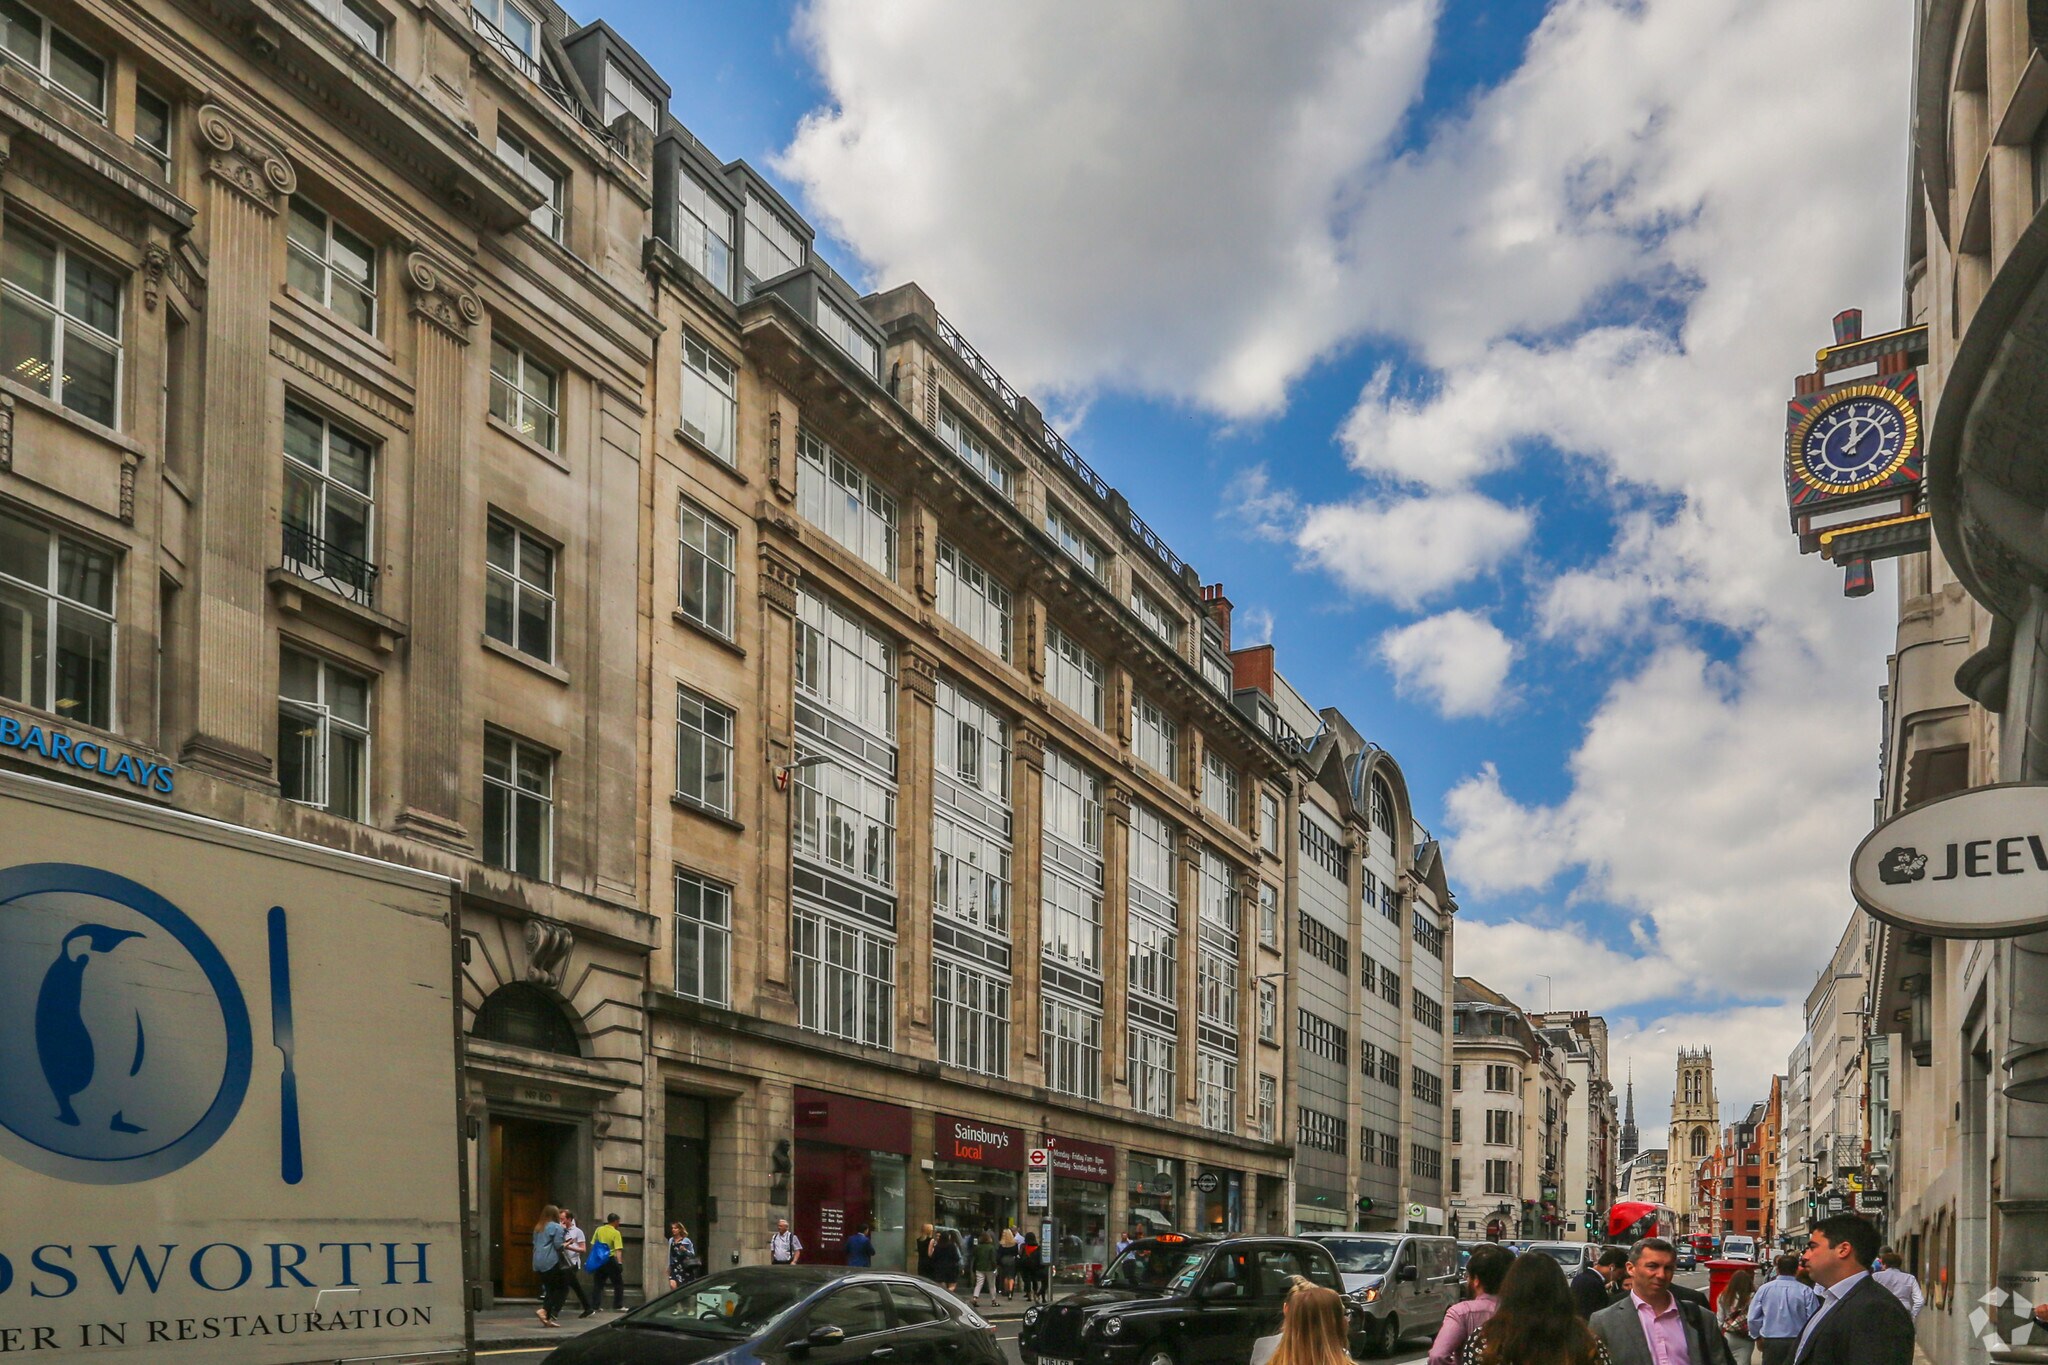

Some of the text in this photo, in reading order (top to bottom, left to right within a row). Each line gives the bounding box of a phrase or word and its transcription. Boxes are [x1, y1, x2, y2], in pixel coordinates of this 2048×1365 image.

[0, 716, 174, 793] BARCLAYS
[954, 1123, 1009, 1149] Sainsbury's
[955, 1140, 983, 1160] Local
[1072, 1152, 1084, 1163] Friday
[1073, 1162, 1087, 1174] Sunday
[0, 1306, 432, 1352] ER IN RESTAURATION
